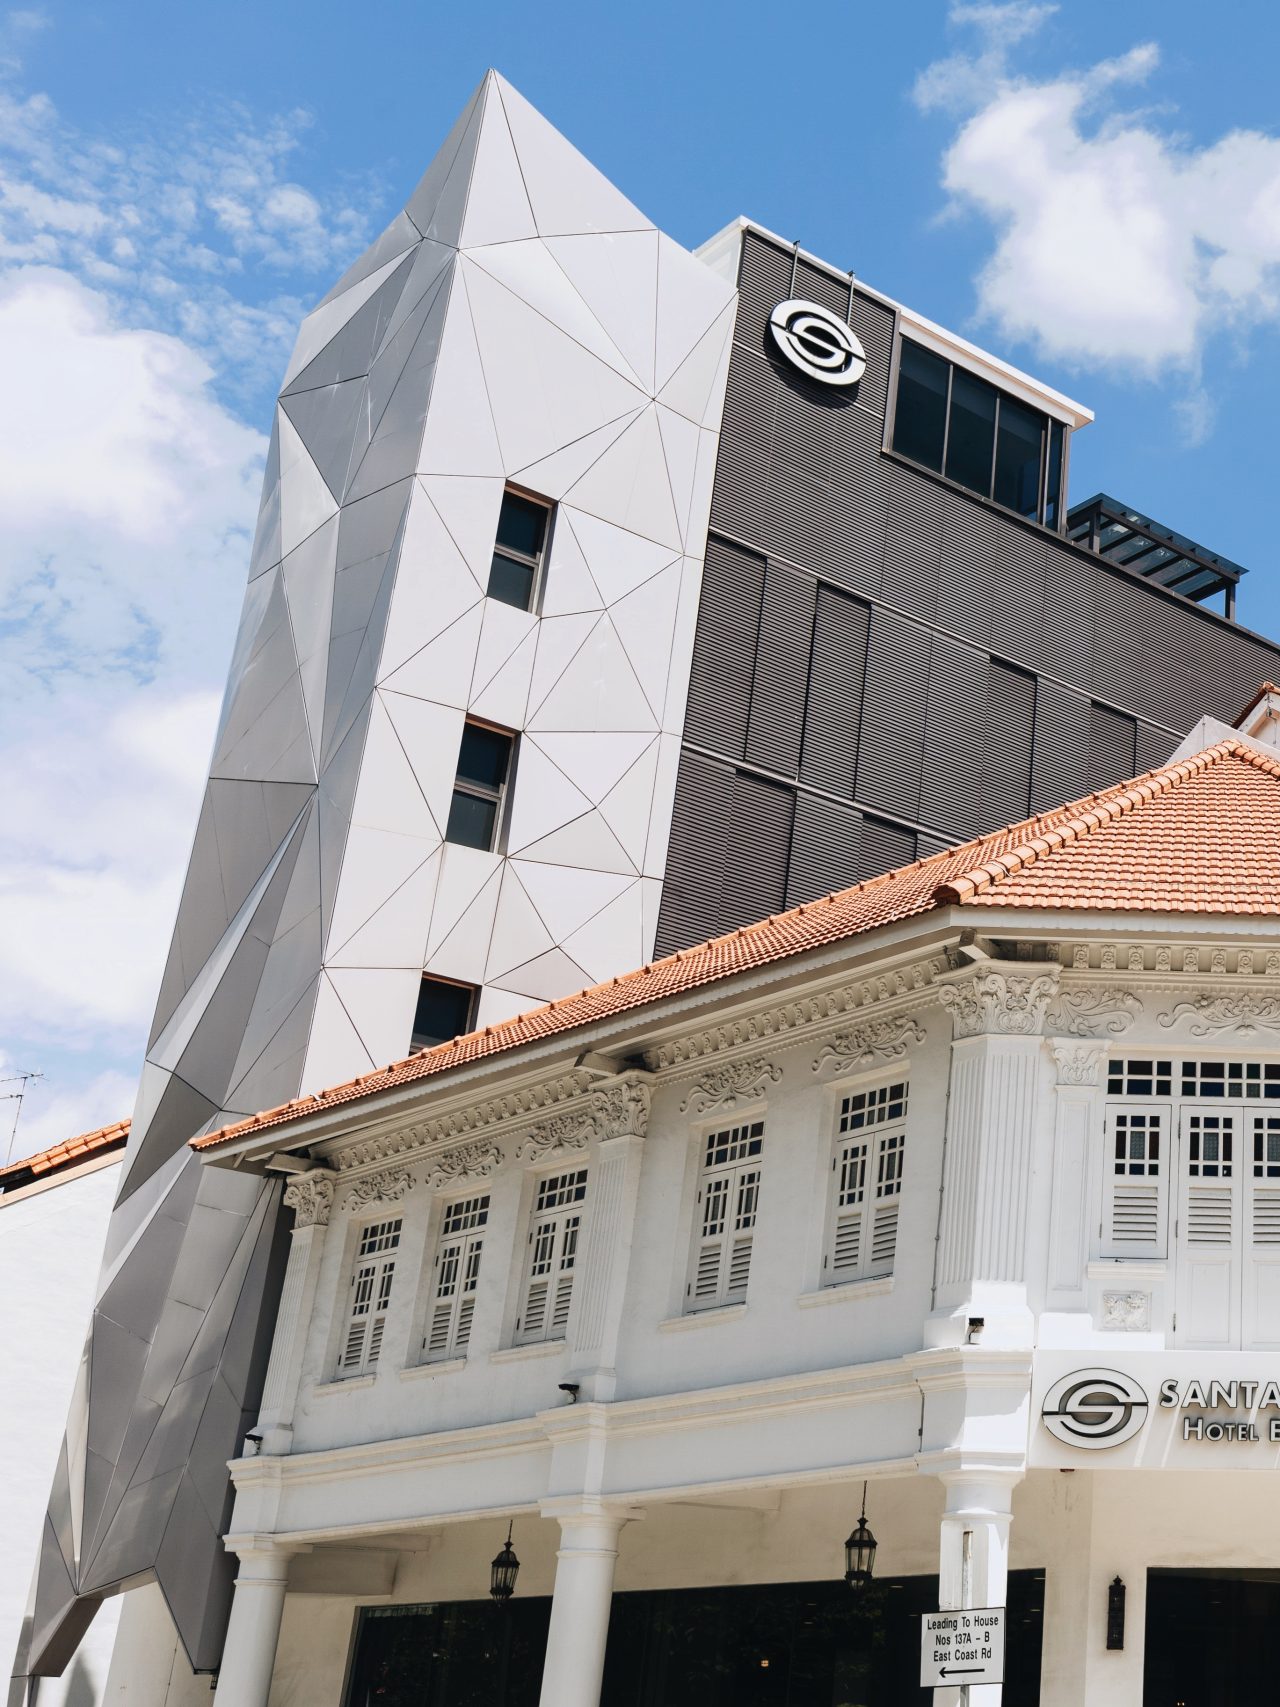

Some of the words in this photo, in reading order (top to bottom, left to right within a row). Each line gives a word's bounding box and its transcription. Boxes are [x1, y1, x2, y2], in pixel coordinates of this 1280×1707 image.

[927, 1618, 957, 1631] Leading
[962, 1616, 970, 1627] To
[974, 1616, 998, 1626] House
[936, 1634, 951, 1645] Nos
[955, 1633, 971, 1644] 137A
[984, 1631, 990, 1642] B
[933, 1650, 951, 1662] East
[955, 1649, 978, 1660] Coast
[981, 1647, 991, 1659] Rd
